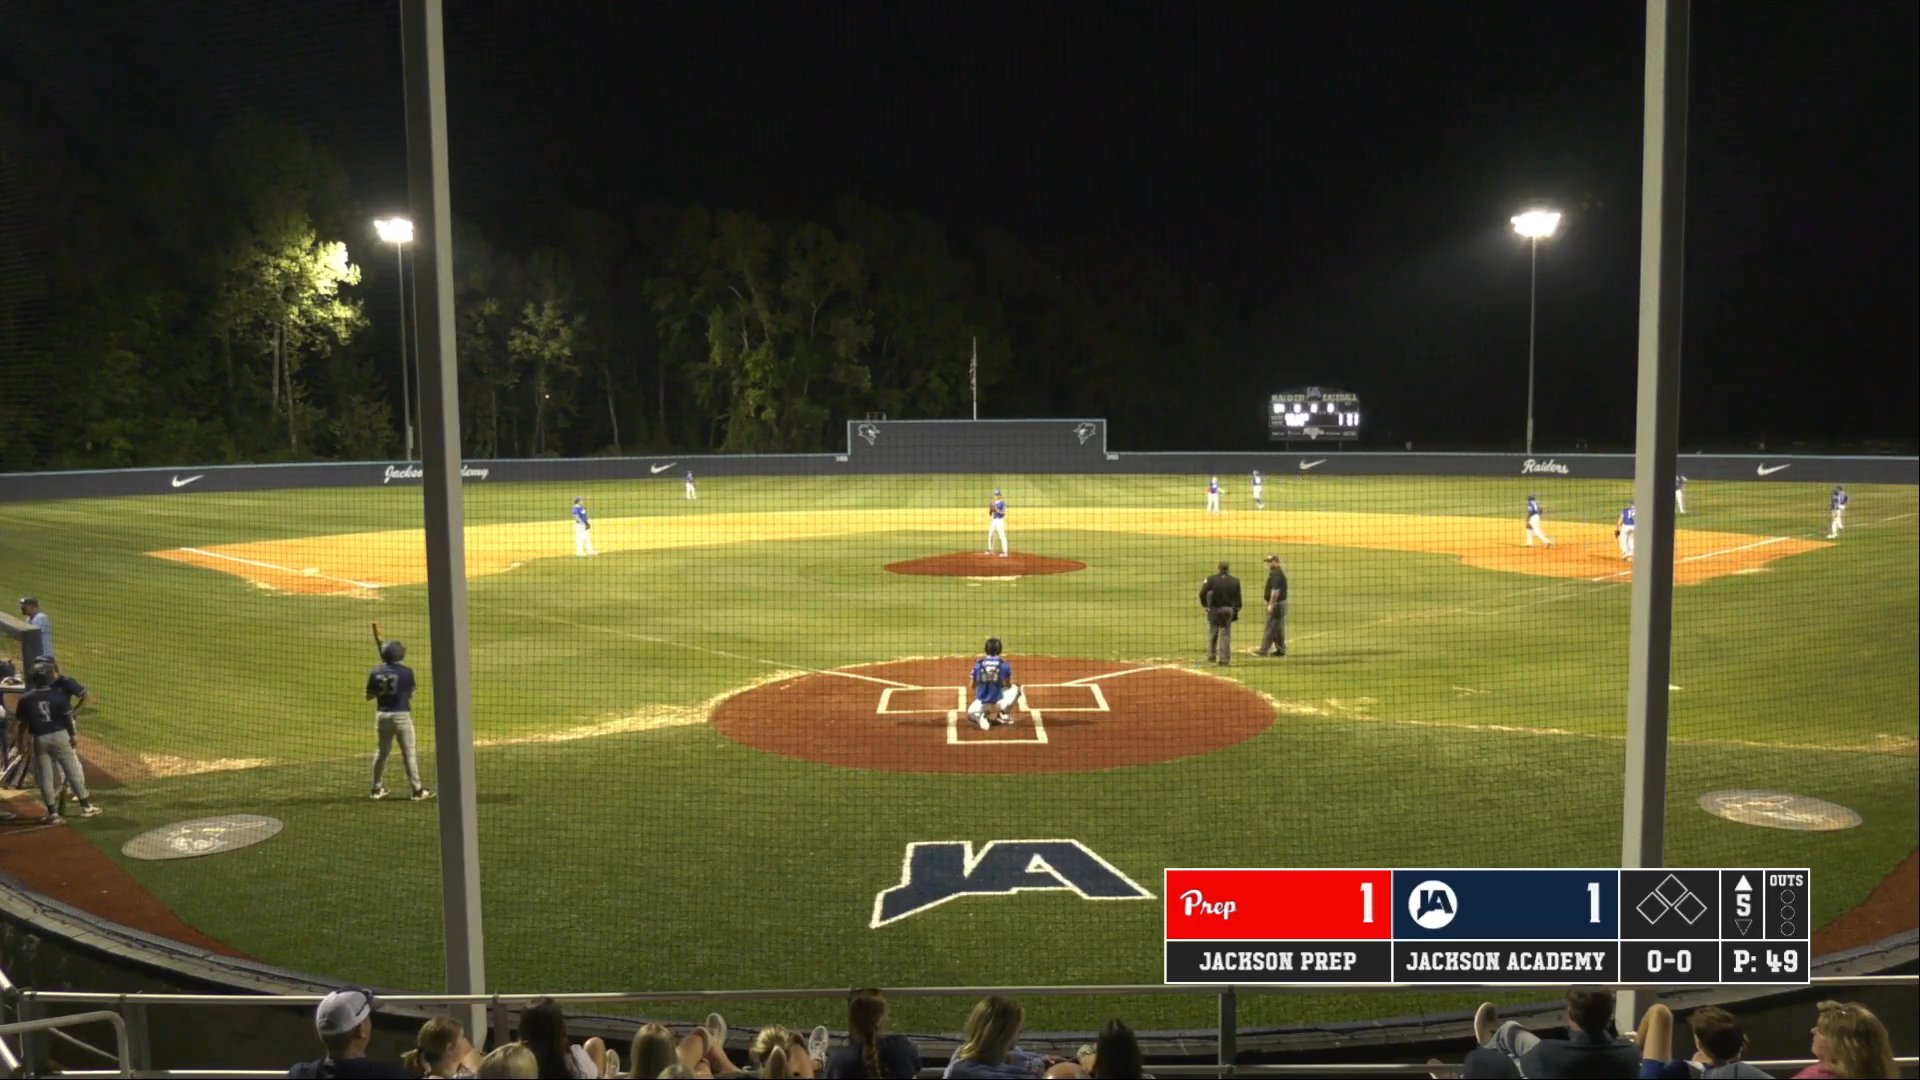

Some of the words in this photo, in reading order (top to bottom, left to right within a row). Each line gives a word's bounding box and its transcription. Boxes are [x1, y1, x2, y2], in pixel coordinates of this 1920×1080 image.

[384, 465, 423, 484] Jackso
[1521, 459, 1569, 474] Raiders
[869, 838, 1157, 929] JA
